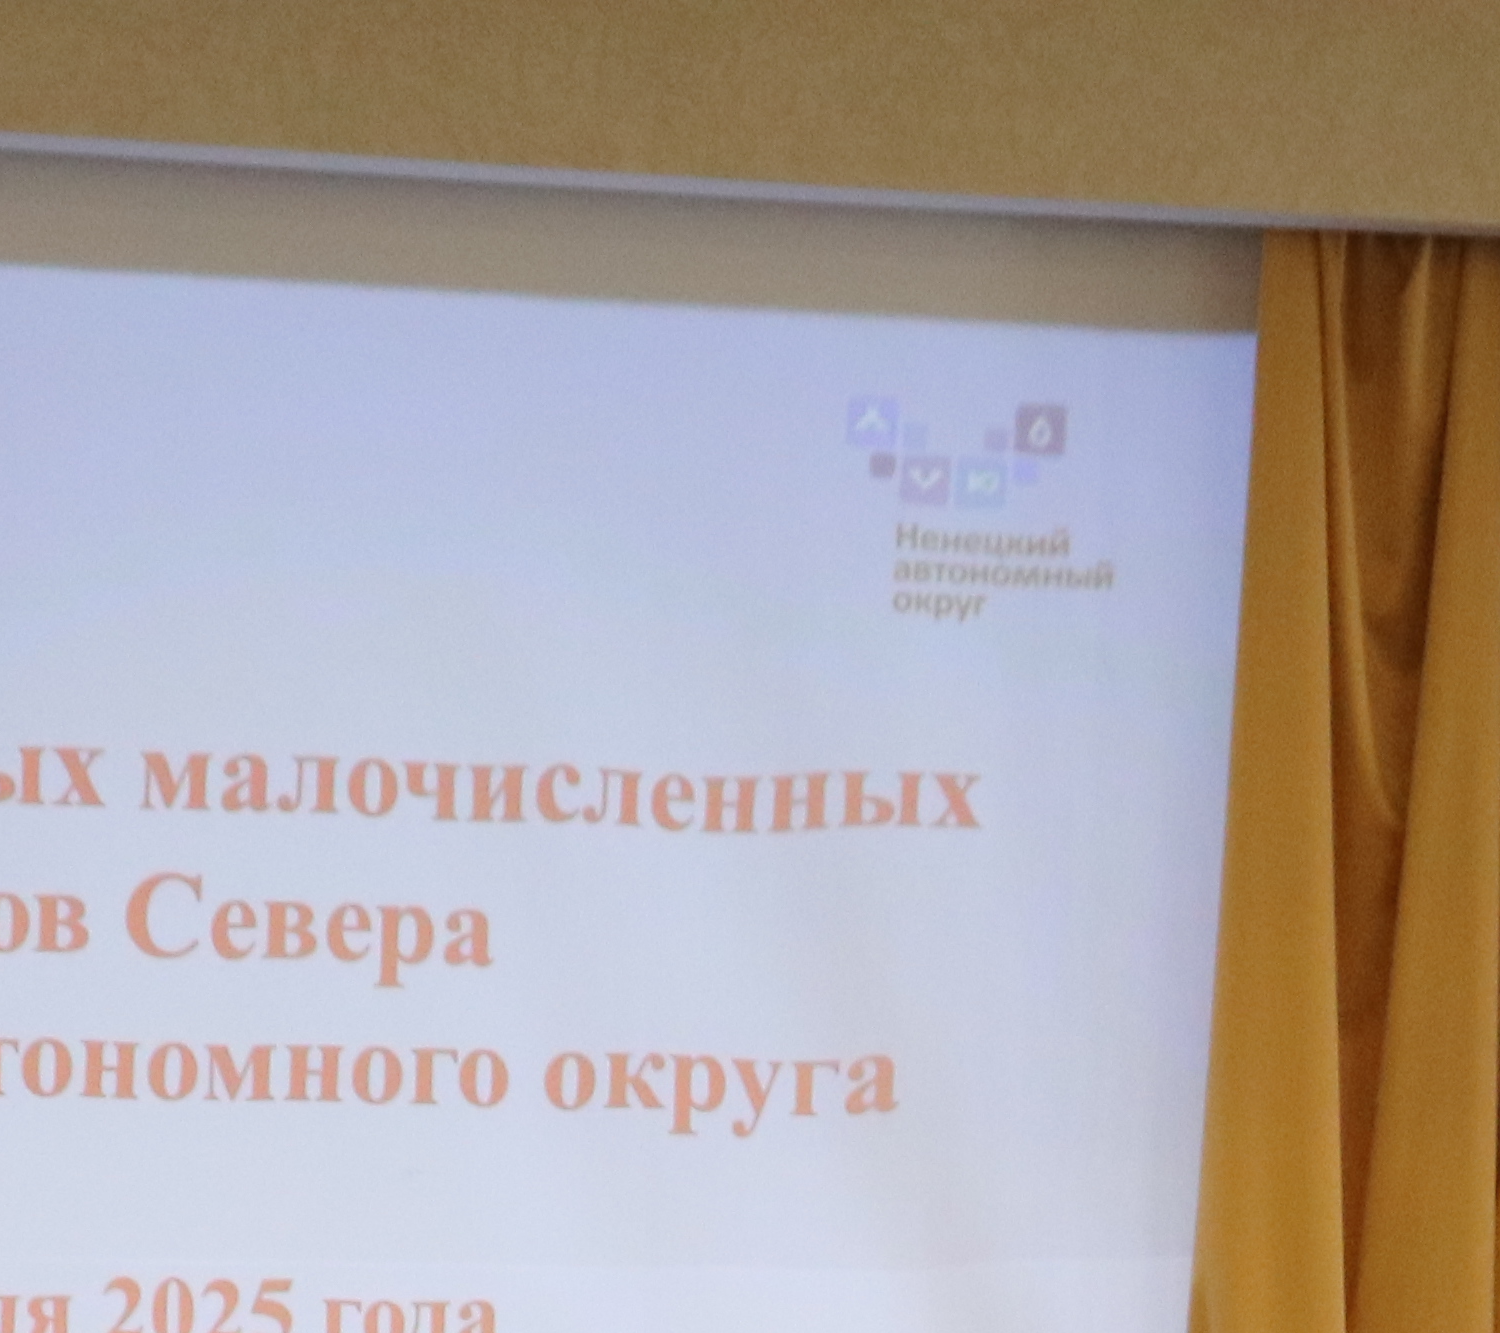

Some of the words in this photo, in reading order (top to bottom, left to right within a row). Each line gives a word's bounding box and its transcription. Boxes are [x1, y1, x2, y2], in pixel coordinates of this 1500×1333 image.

[896, 523, 1071, 557] Ненецкий
[893, 559, 1114, 591] автономный
[892, 591, 988, 622] округ
[142, 747, 978, 835] малочисленных
[125, 871, 490, 986] Севера
[544, 1051, 894, 1136] округа
